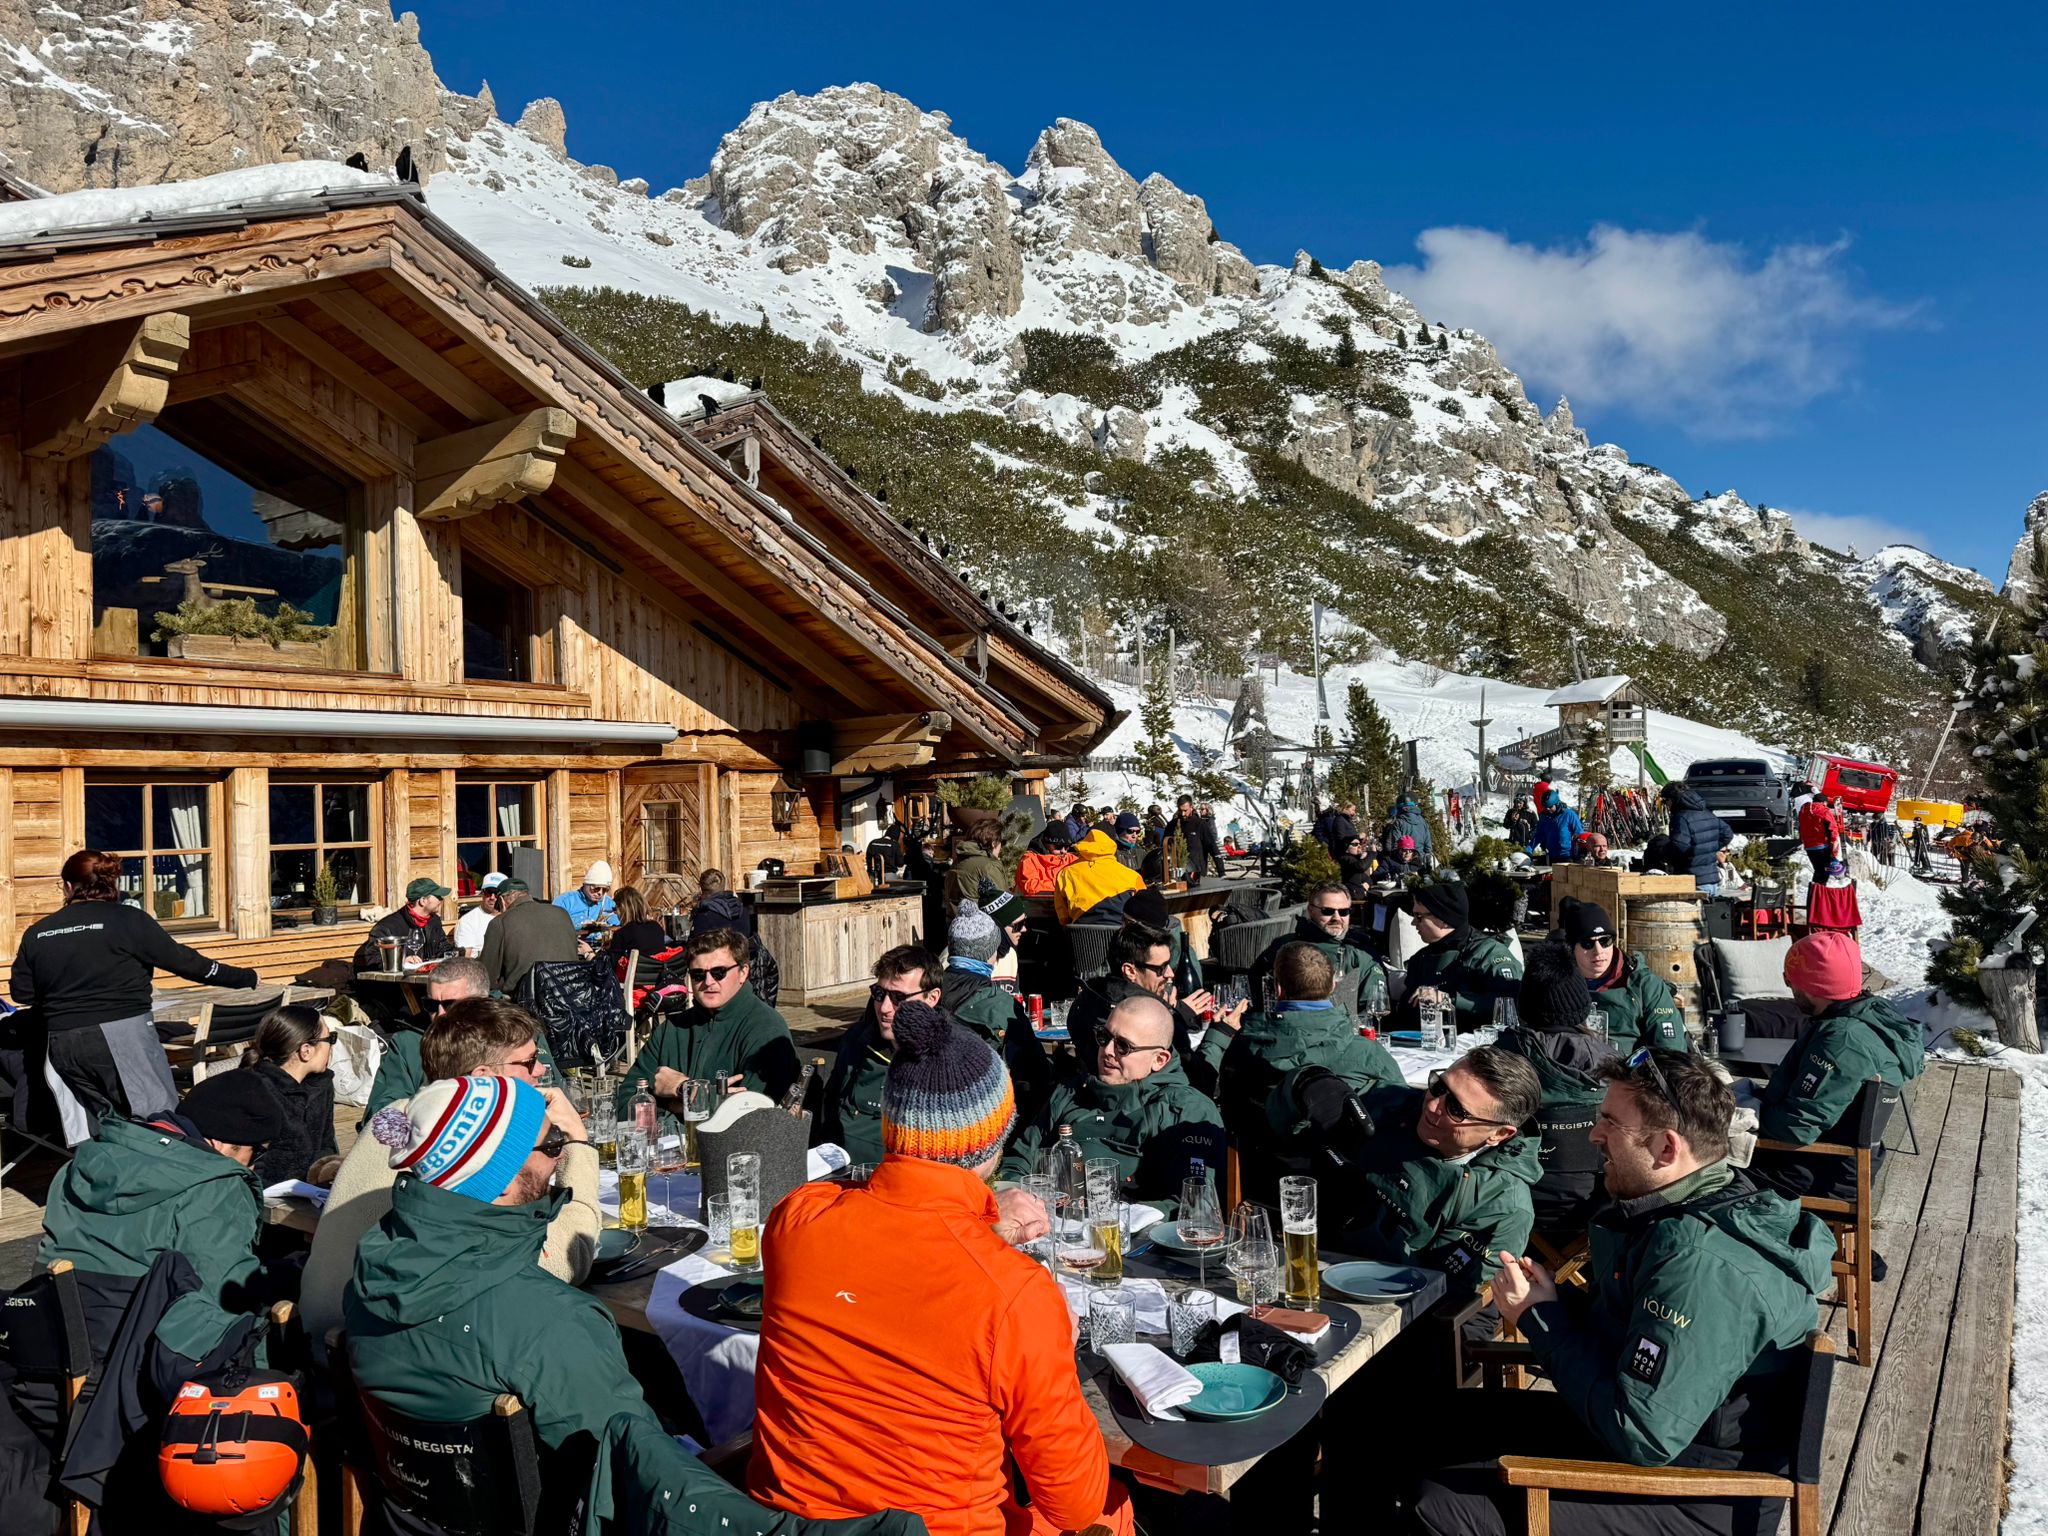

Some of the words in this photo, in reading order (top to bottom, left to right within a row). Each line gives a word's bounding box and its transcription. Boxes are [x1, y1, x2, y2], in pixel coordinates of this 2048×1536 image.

[37, 923, 104, 939] PORSCHE
[1654, 1007, 1674, 1015] IQUW
[1809, 1054, 1834, 1071] IQUW
[1552, 1121, 1594, 1130] REGISTA
[1459, 1231, 1493, 1259] IQUW
[1643, 1297, 1692, 1329] IQUW
[1633, 1359, 1652, 1375] TEC
[1635, 1352, 1655, 1368] MON
[413, 1439, 474, 1454] REGISTA
